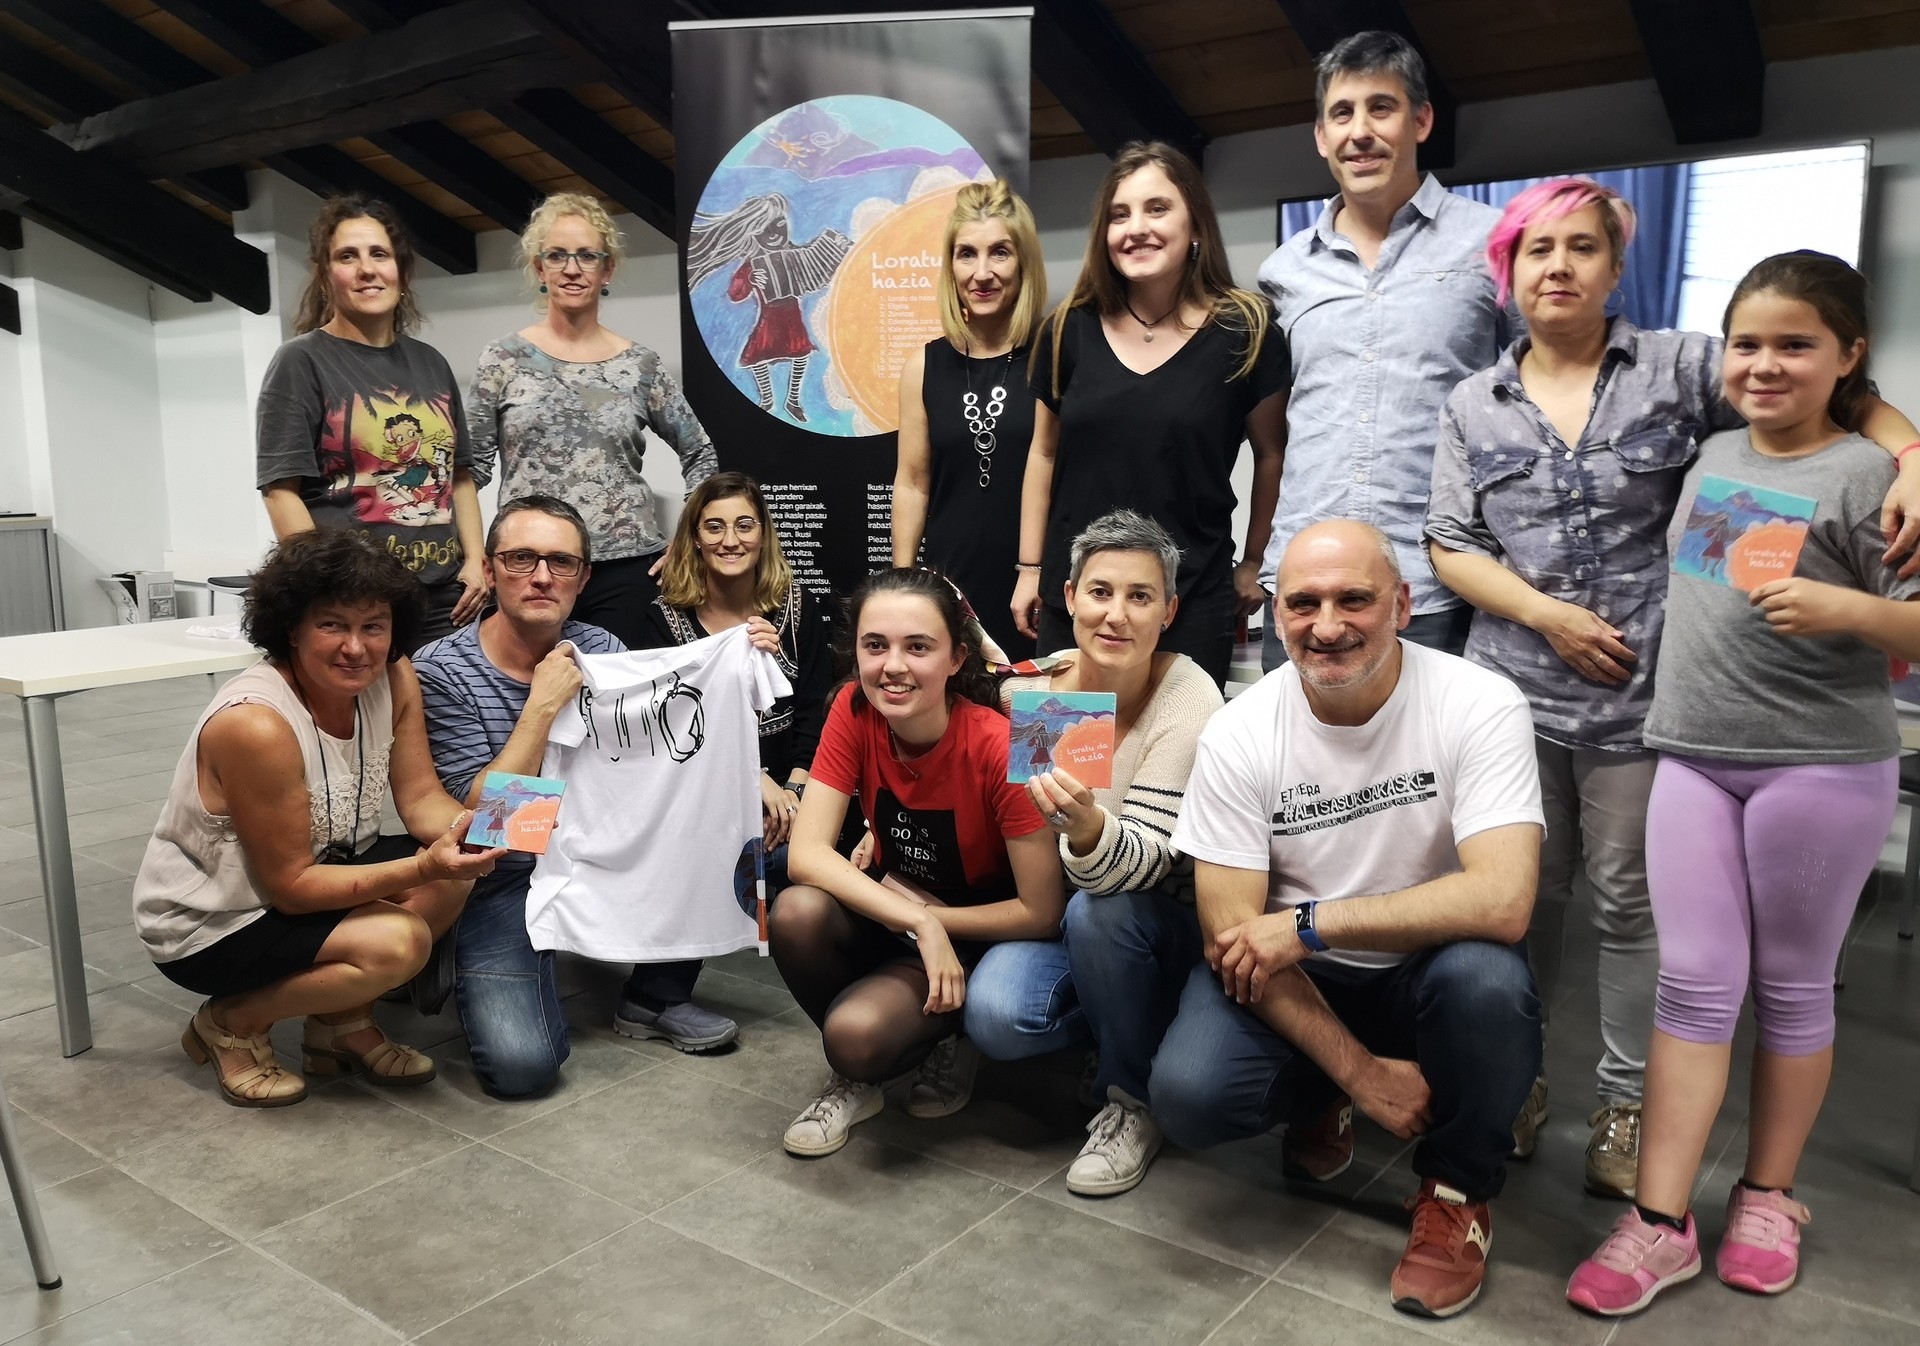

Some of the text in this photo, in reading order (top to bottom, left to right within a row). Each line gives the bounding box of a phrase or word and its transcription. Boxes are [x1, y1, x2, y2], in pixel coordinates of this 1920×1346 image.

[871, 250, 943, 269] Loratu
[871, 272, 932, 289] hazia
[775, 493, 804, 501] pandero
[867, 493, 887, 502] lagun
[868, 545, 892, 553] pander
[1067, 742, 1109, 755] Loratu da
[1073, 752, 1105, 763] hazia
[1280, 782, 1321, 803] ETXERA
[521, 825, 545, 833] hazia
[895, 842, 938, 863] DRESS
